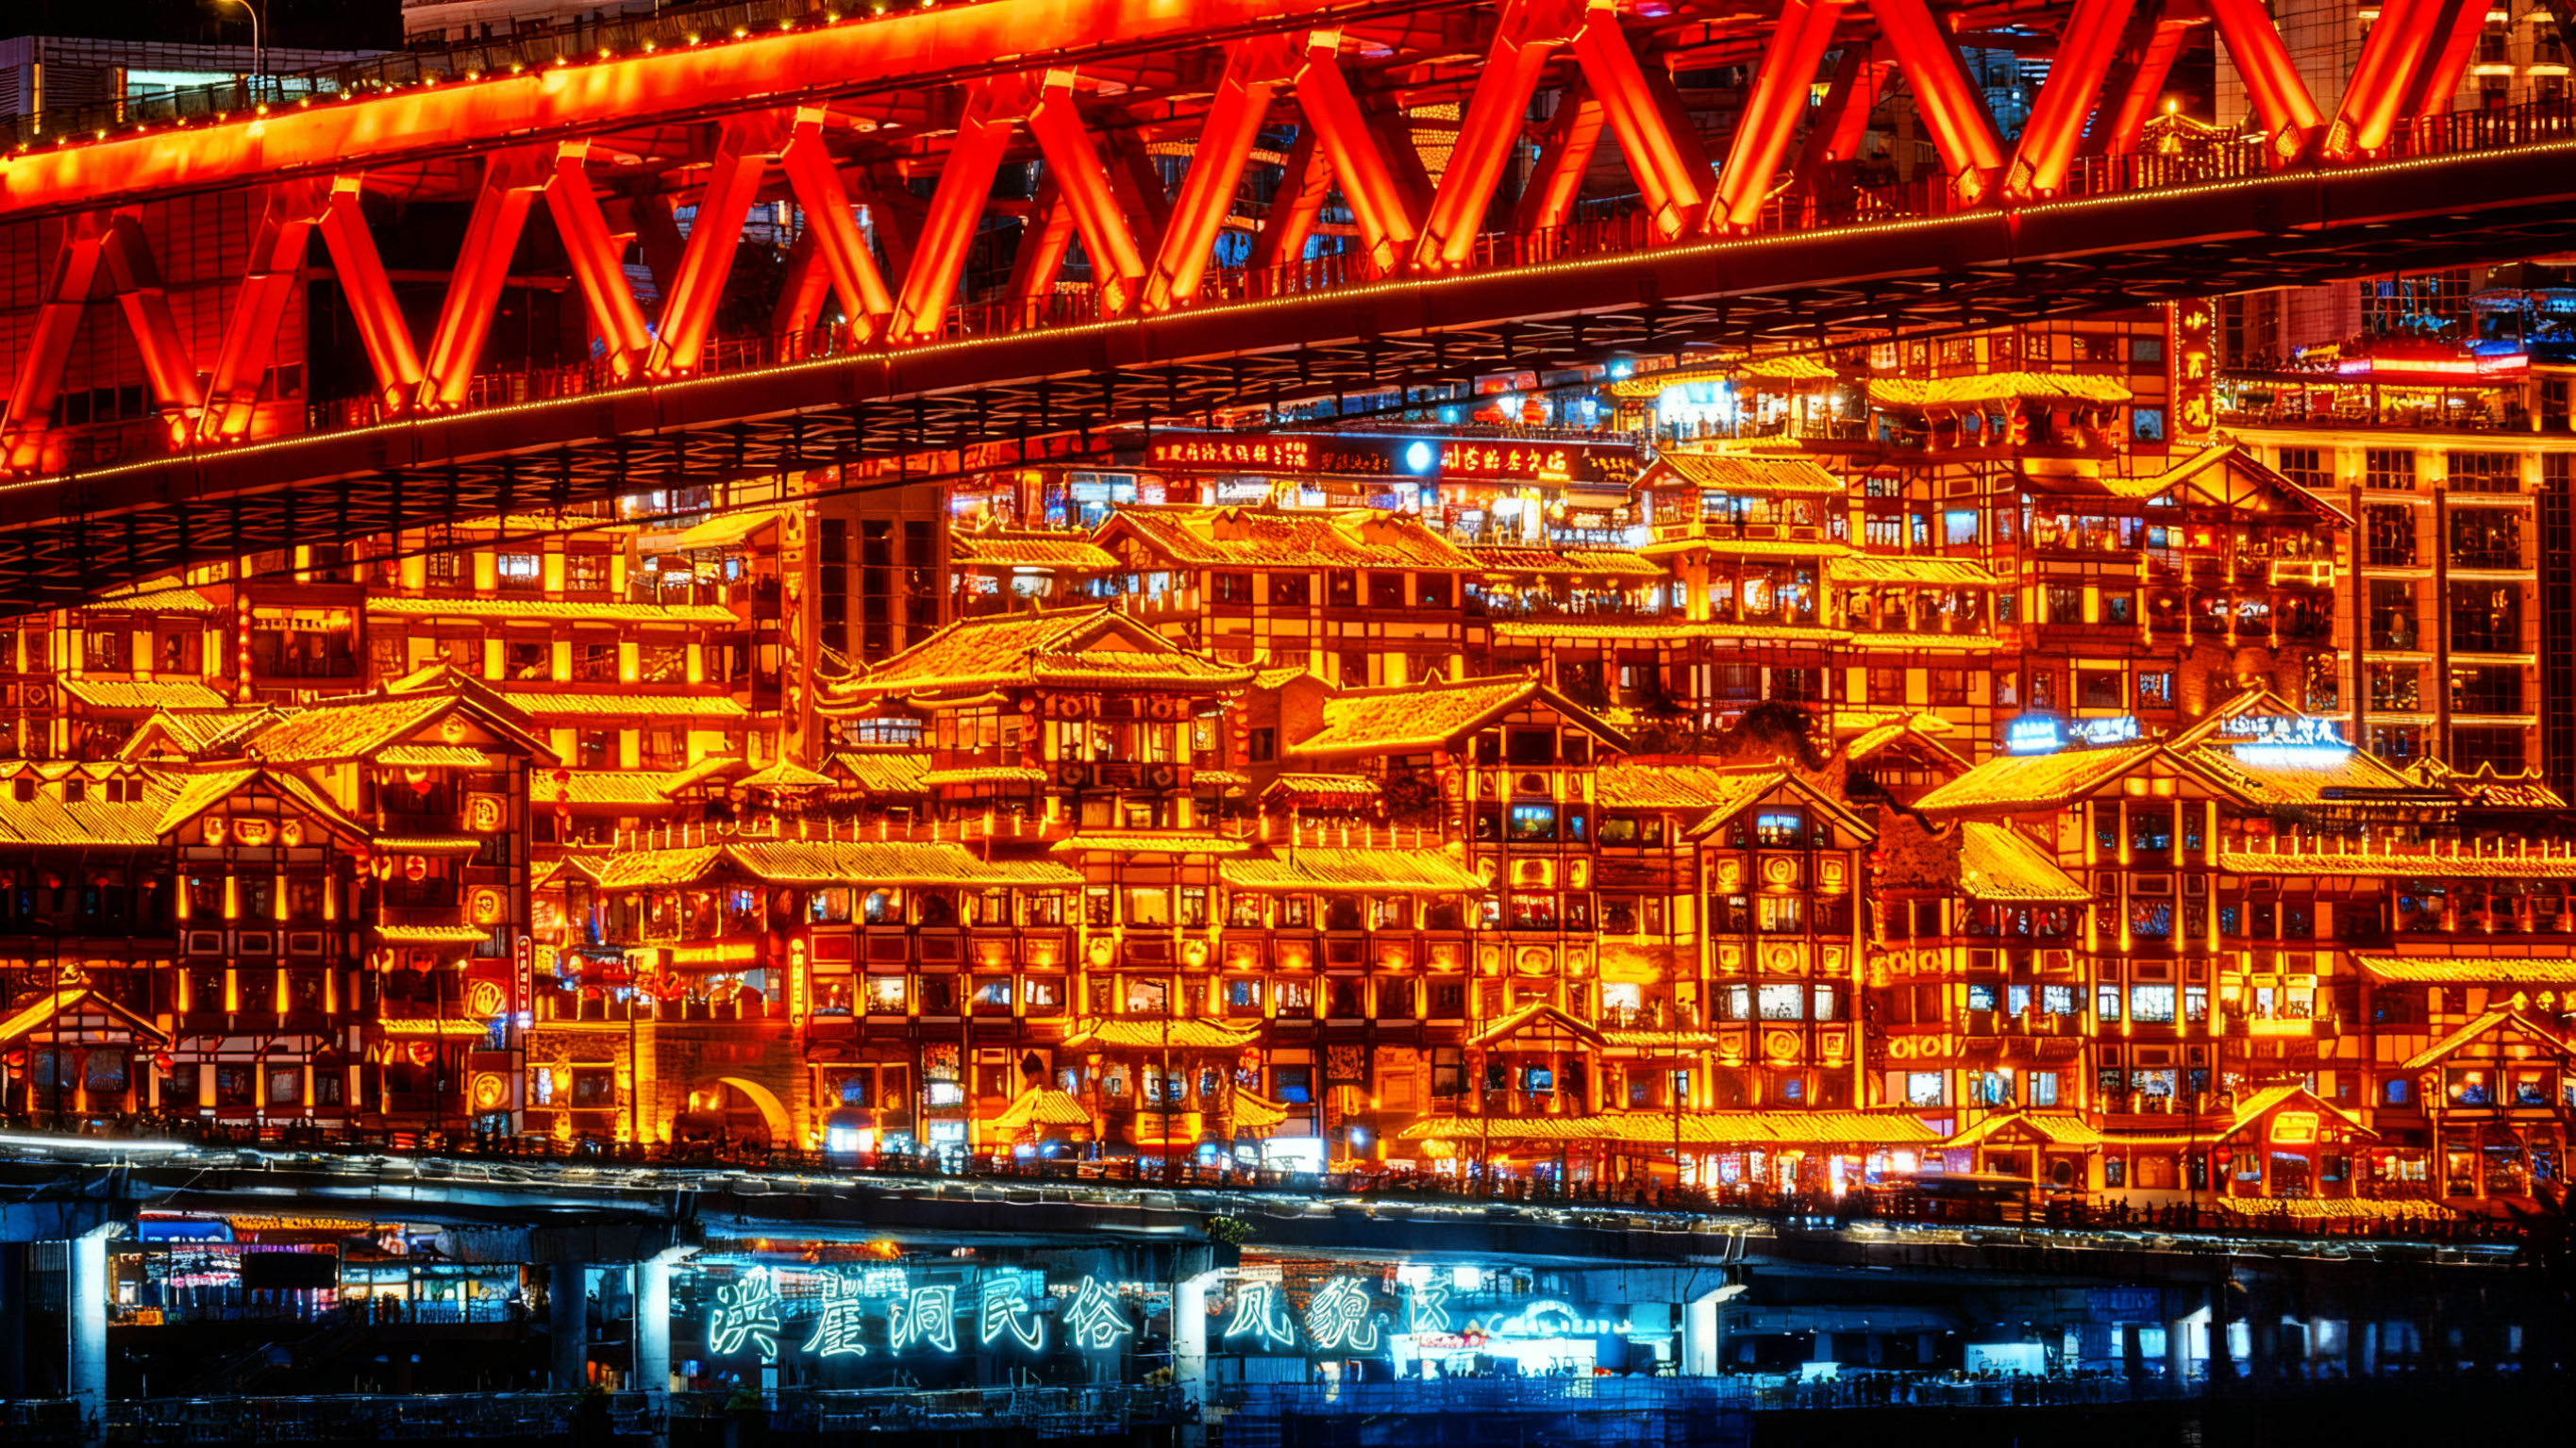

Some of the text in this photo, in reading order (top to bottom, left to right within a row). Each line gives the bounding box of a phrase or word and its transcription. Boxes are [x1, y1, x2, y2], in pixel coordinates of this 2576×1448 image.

[708, 1264, 1133, 1358] 洪崖洞民俗
